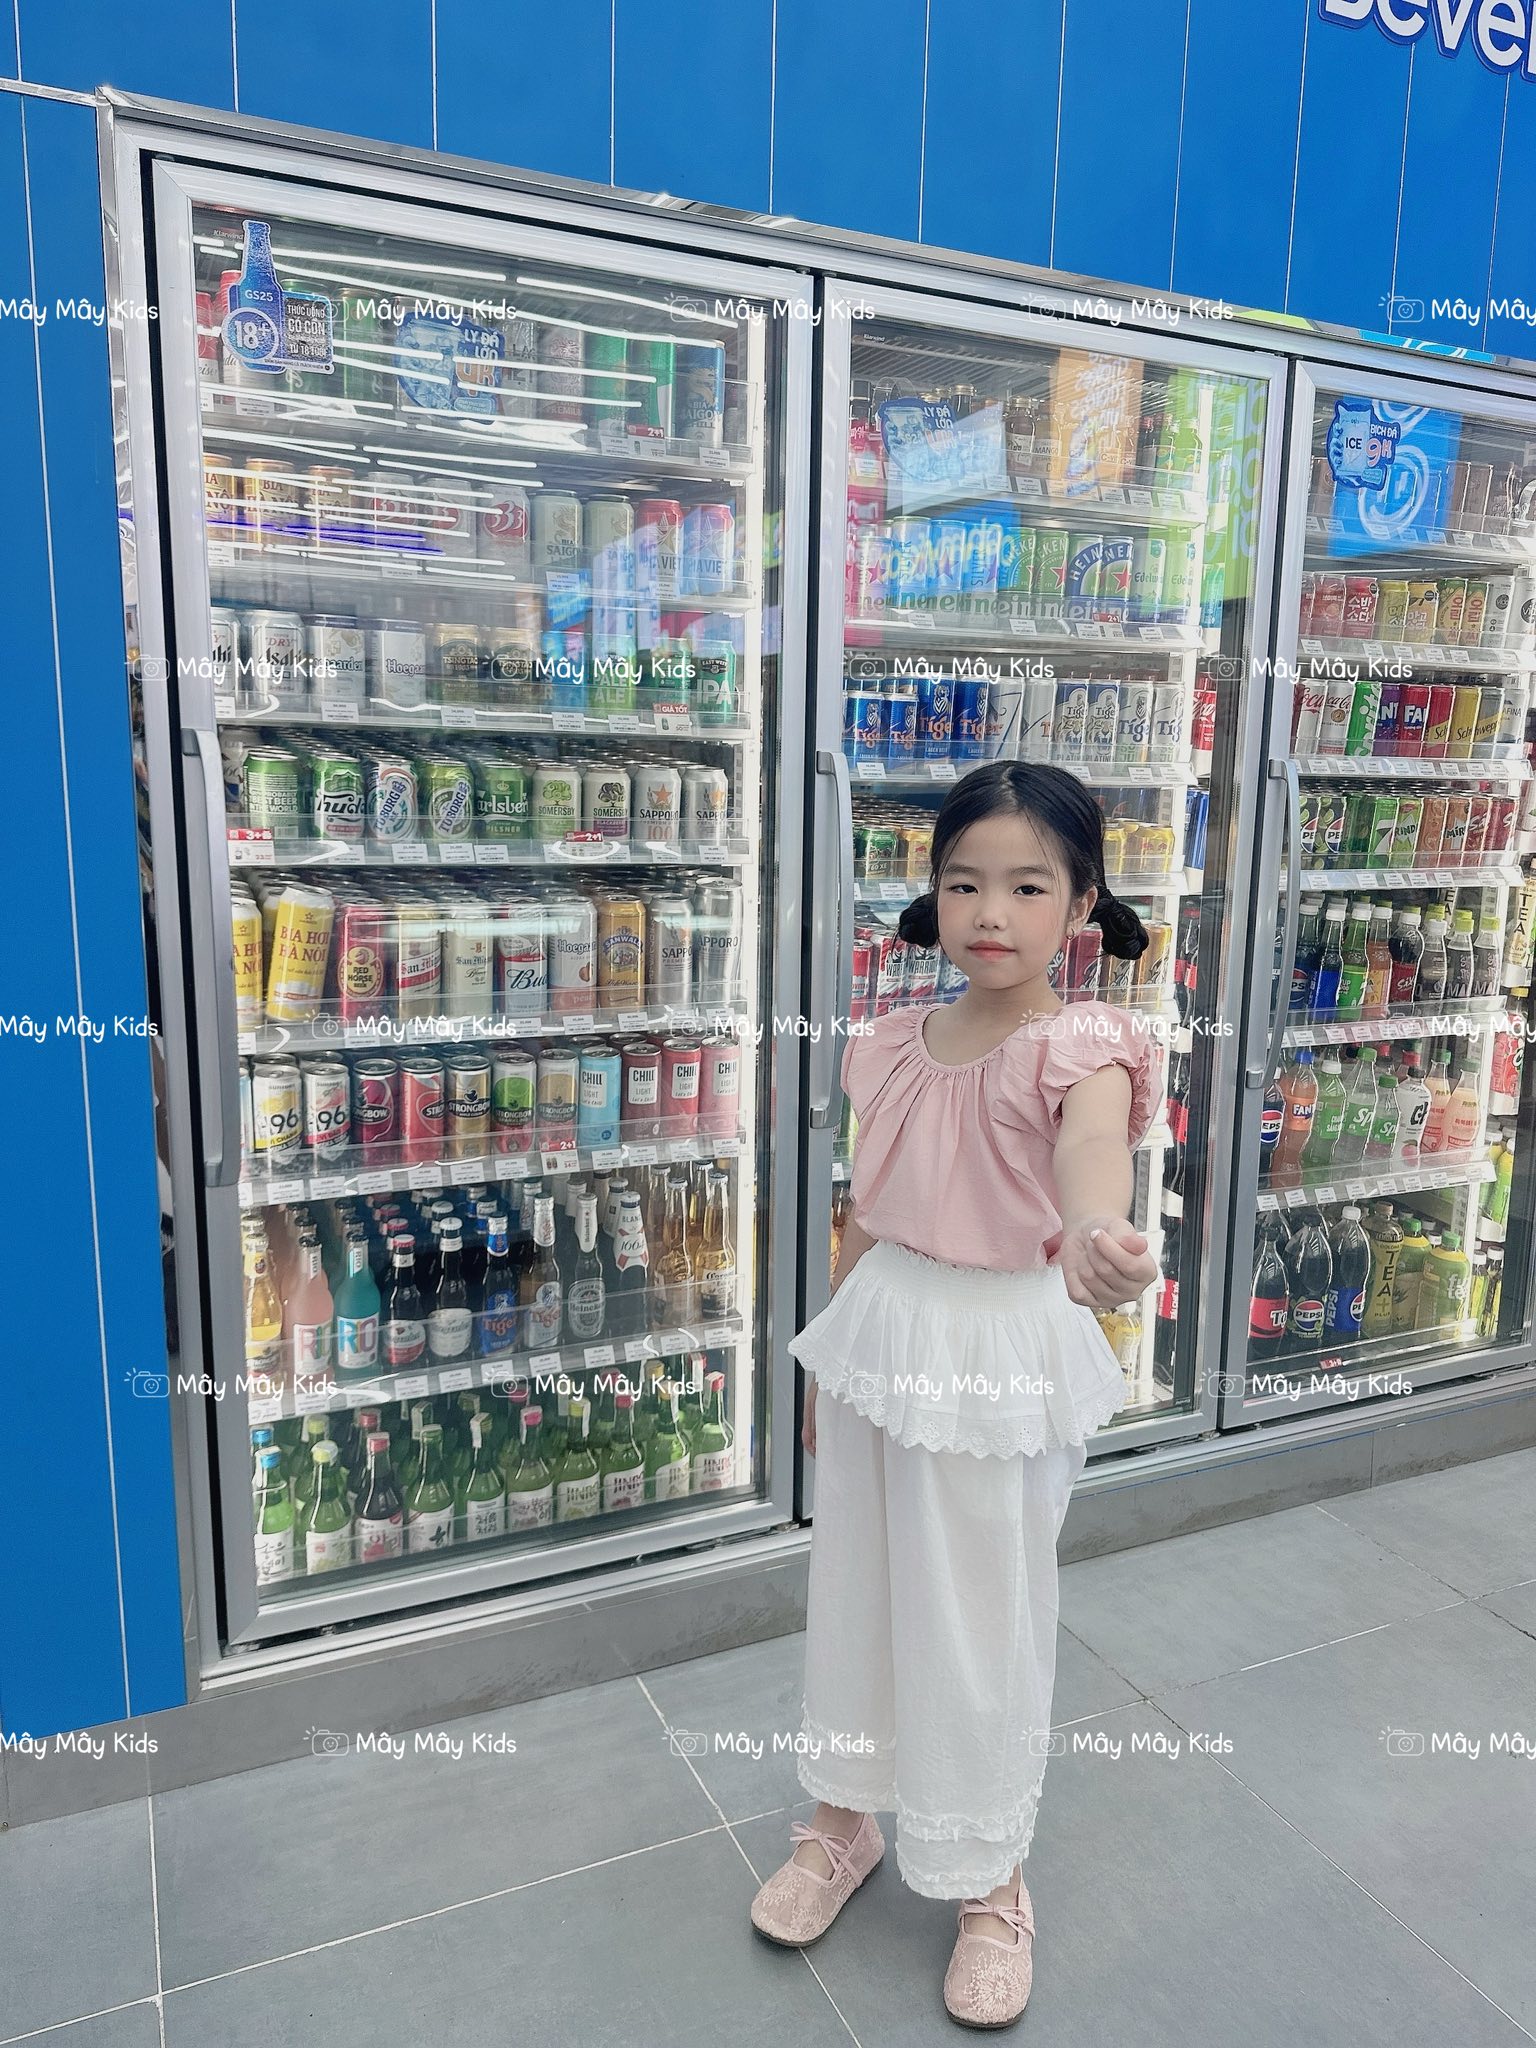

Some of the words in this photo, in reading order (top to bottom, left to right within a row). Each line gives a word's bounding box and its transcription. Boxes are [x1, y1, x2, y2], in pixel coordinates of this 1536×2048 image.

[245, 289, 274, 302] GS25
[234, 319, 272, 351] 18+
[647, 427, 664, 438] 2+1
[1387, 425, 1398, 439] ĐÁ
[1345, 437, 1363, 450] ICE
[491, 500, 523, 532] 333
[1348, 595, 1373, 612] 수박
[1107, 614, 1120, 623] 2+1
[1347, 610, 1371, 623] 소다
[594, 687, 626, 704] ALE
[697, 679, 732, 705] IPA
[661, 704, 675, 713] GIÁ
[675, 704, 688, 714] TỐT
[376, 790, 403, 831] TUBORG
[438, 791, 467, 832] TUBORG
[537, 806, 576, 816] SOMERSBY
[593, 807, 628, 817] SOMERSBY
[586, 832, 603, 842] 2+1
[280, 925, 303, 943] BIA
[353, 966, 369, 974] RED
[348, 974, 373, 983] HORSE
[582, 1070, 603, 1085] CHILL
[632, 1069, 654, 1082] CHILL
[635, 1087, 651, 1095] LIGHT
[679, 1082, 694, 1091] LIGHT
[583, 1089, 599, 1098] LIGHT
[560, 1141, 576, 1150] 2+1
[311, 1255, 319, 1273] RIO
[1295, 1310, 1323, 1319] PEPSI
[1325, 1289, 1339, 1328] PEPSI
[338, 1315, 377, 1354] RIO
